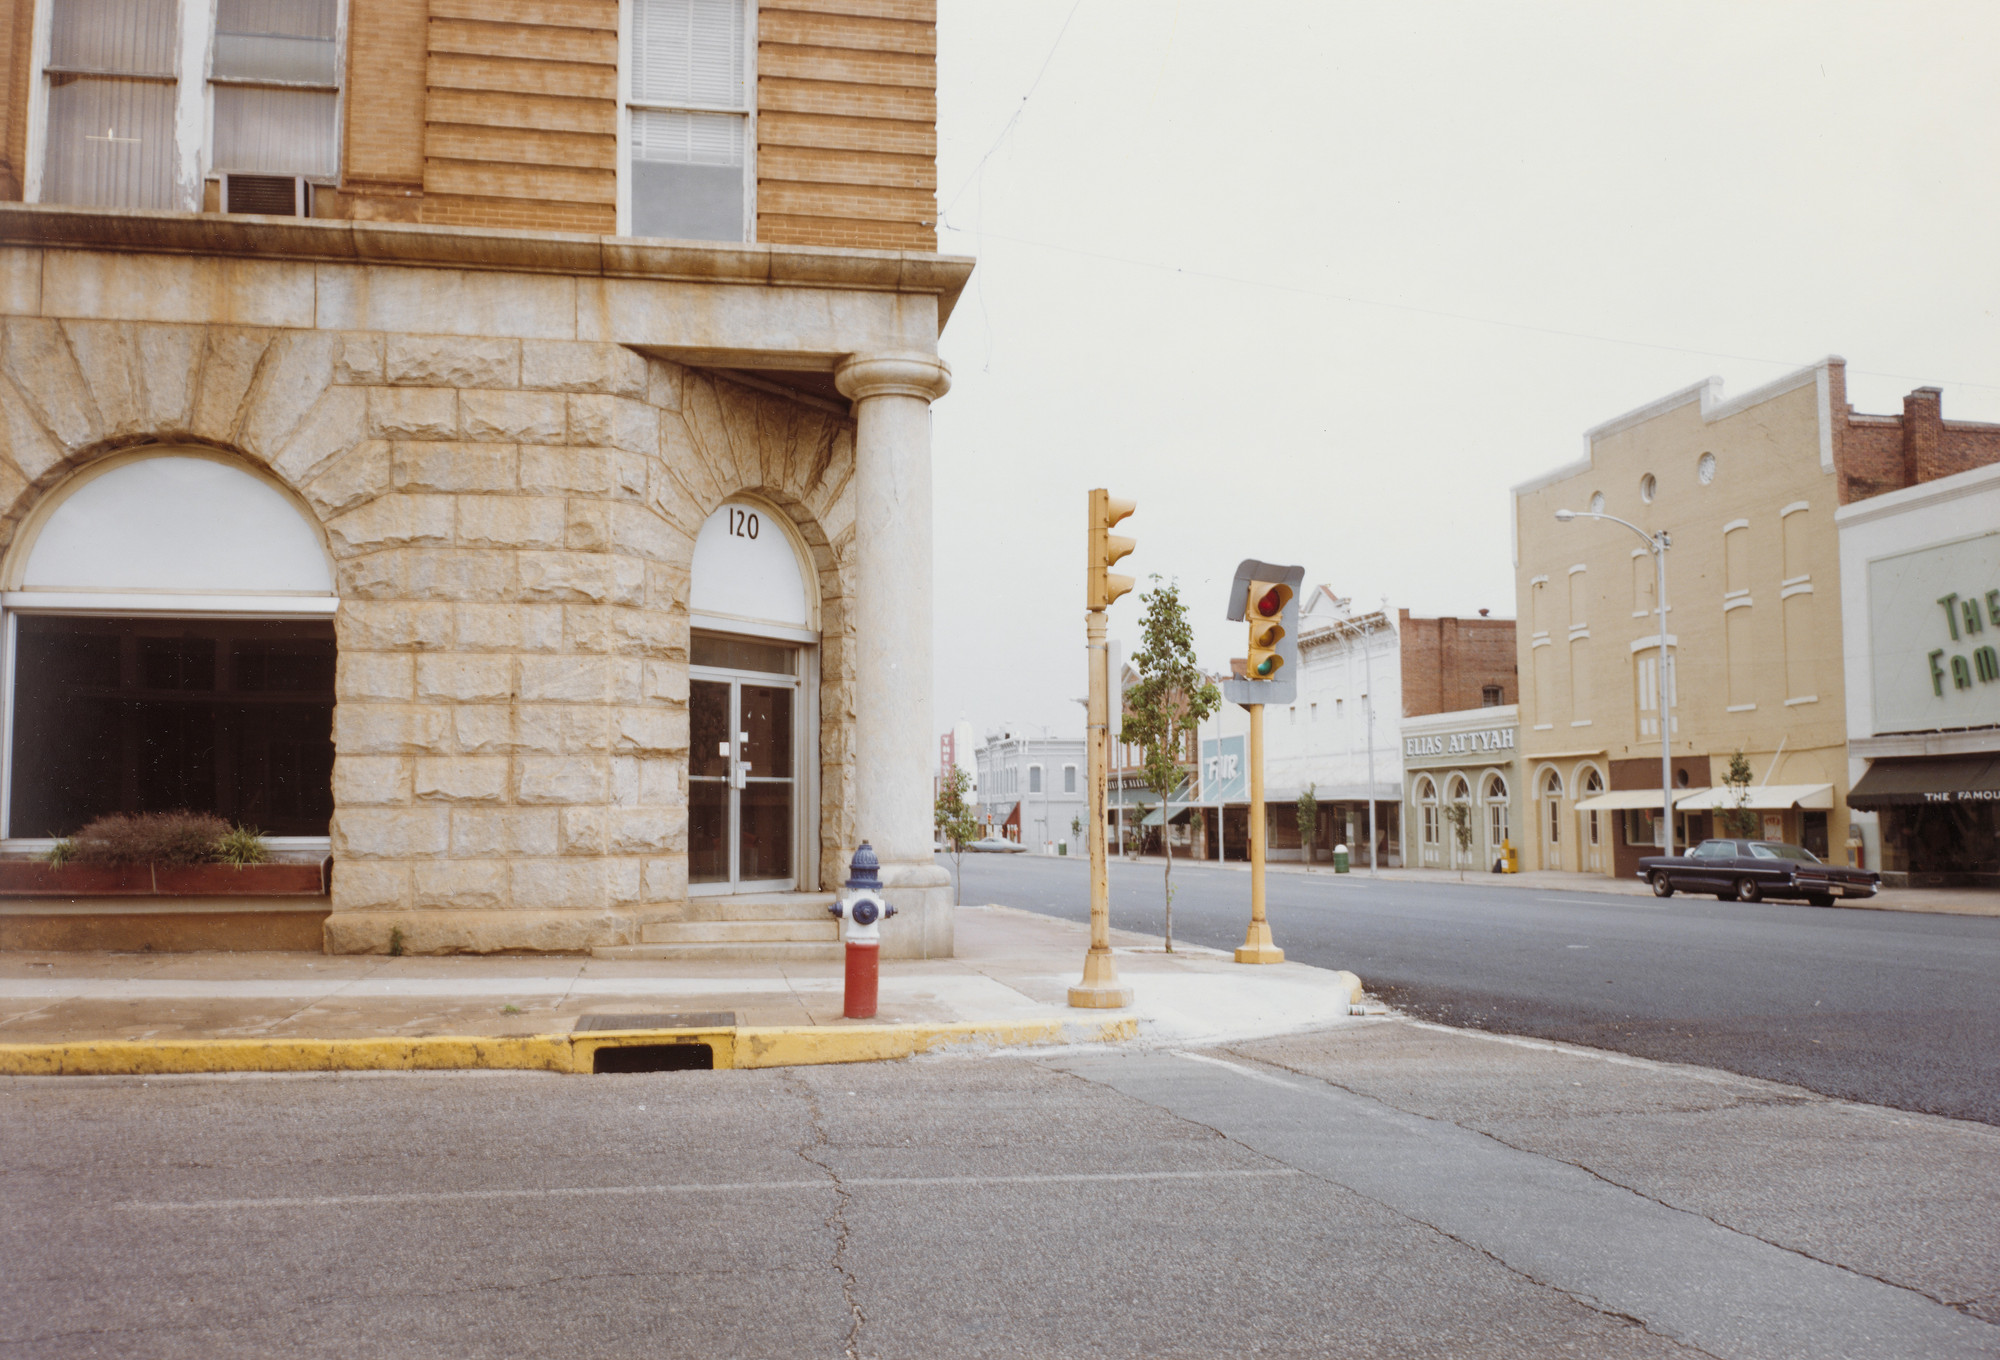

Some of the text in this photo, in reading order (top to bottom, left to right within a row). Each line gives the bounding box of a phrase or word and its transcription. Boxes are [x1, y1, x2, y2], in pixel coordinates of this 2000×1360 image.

[730, 507, 759, 540] 120
[1936, 589, 2000, 641] THE
[1928, 645, 1999, 697] FAM
[1406, 728, 1514, 756] ELIAS ATTYAH
[1924, 792, 1950, 801] THE
